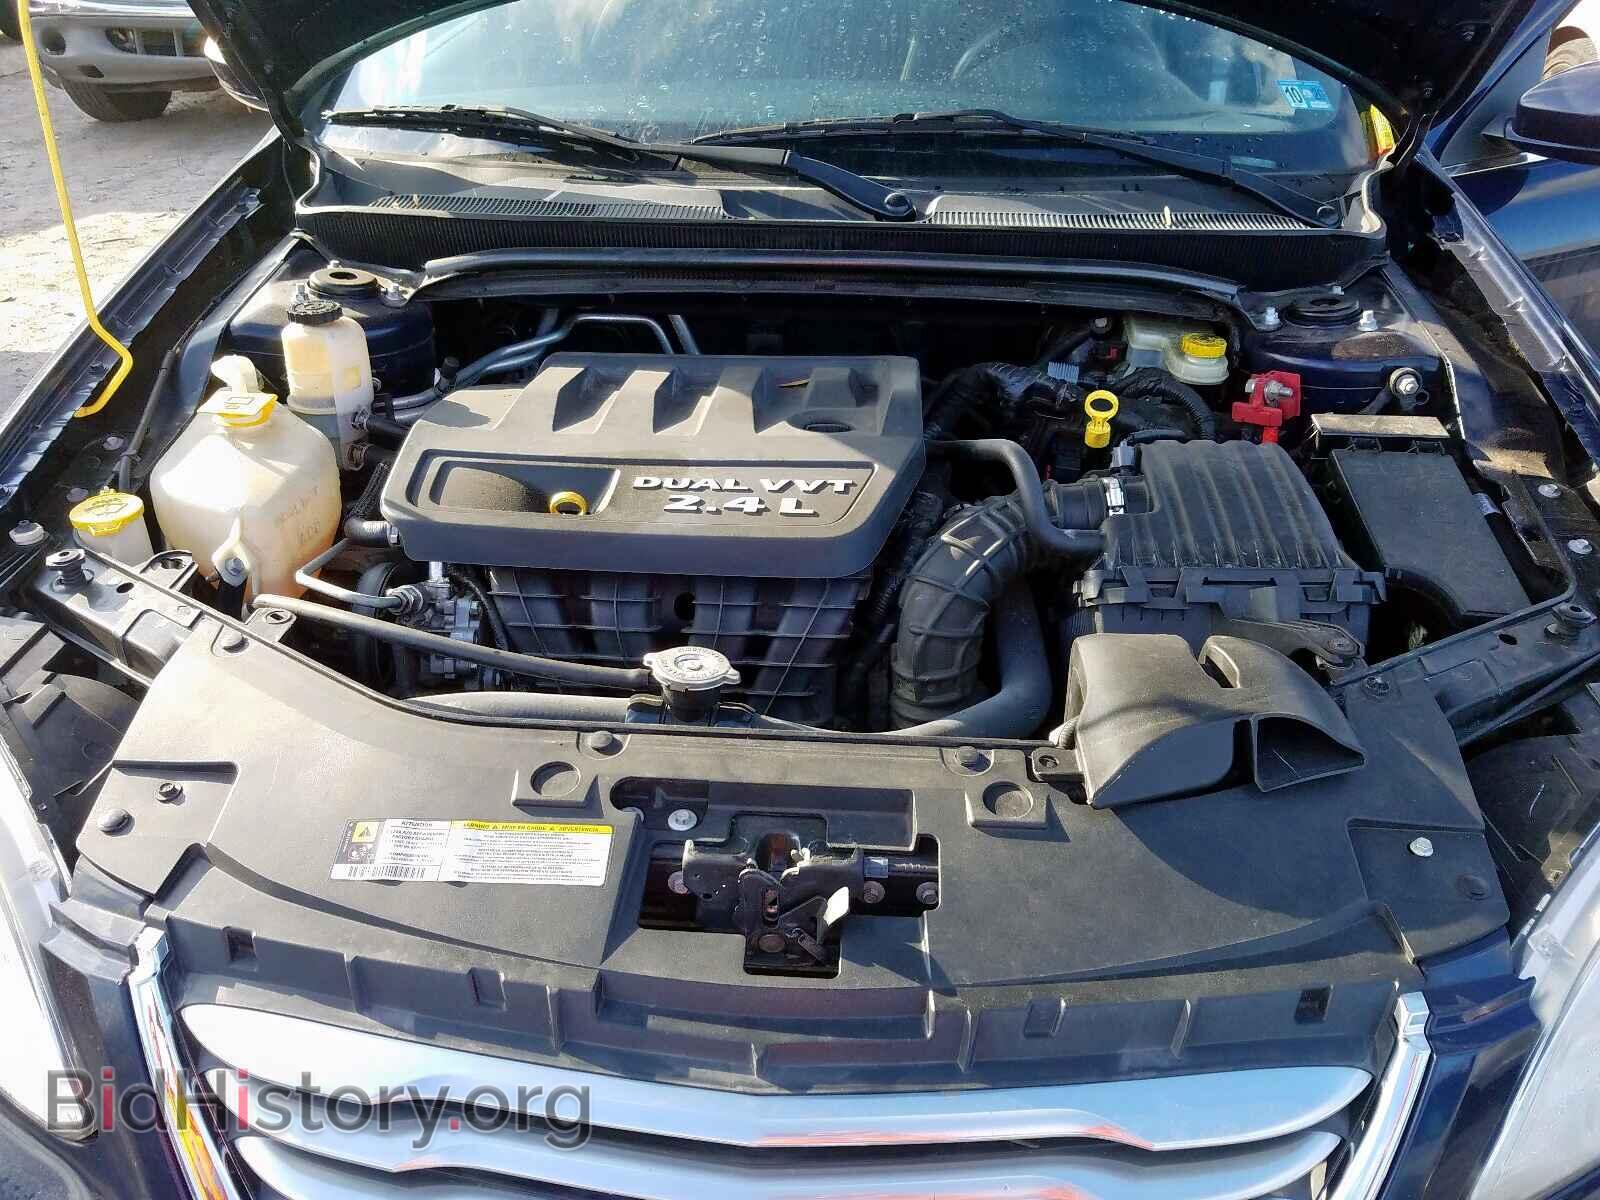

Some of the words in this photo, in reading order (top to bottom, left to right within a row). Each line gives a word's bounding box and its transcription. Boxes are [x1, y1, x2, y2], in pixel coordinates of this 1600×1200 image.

[1285, 86, 1304, 104] 10
[633, 476, 753, 493] DUAL
[760, 478, 858, 494] VVT
